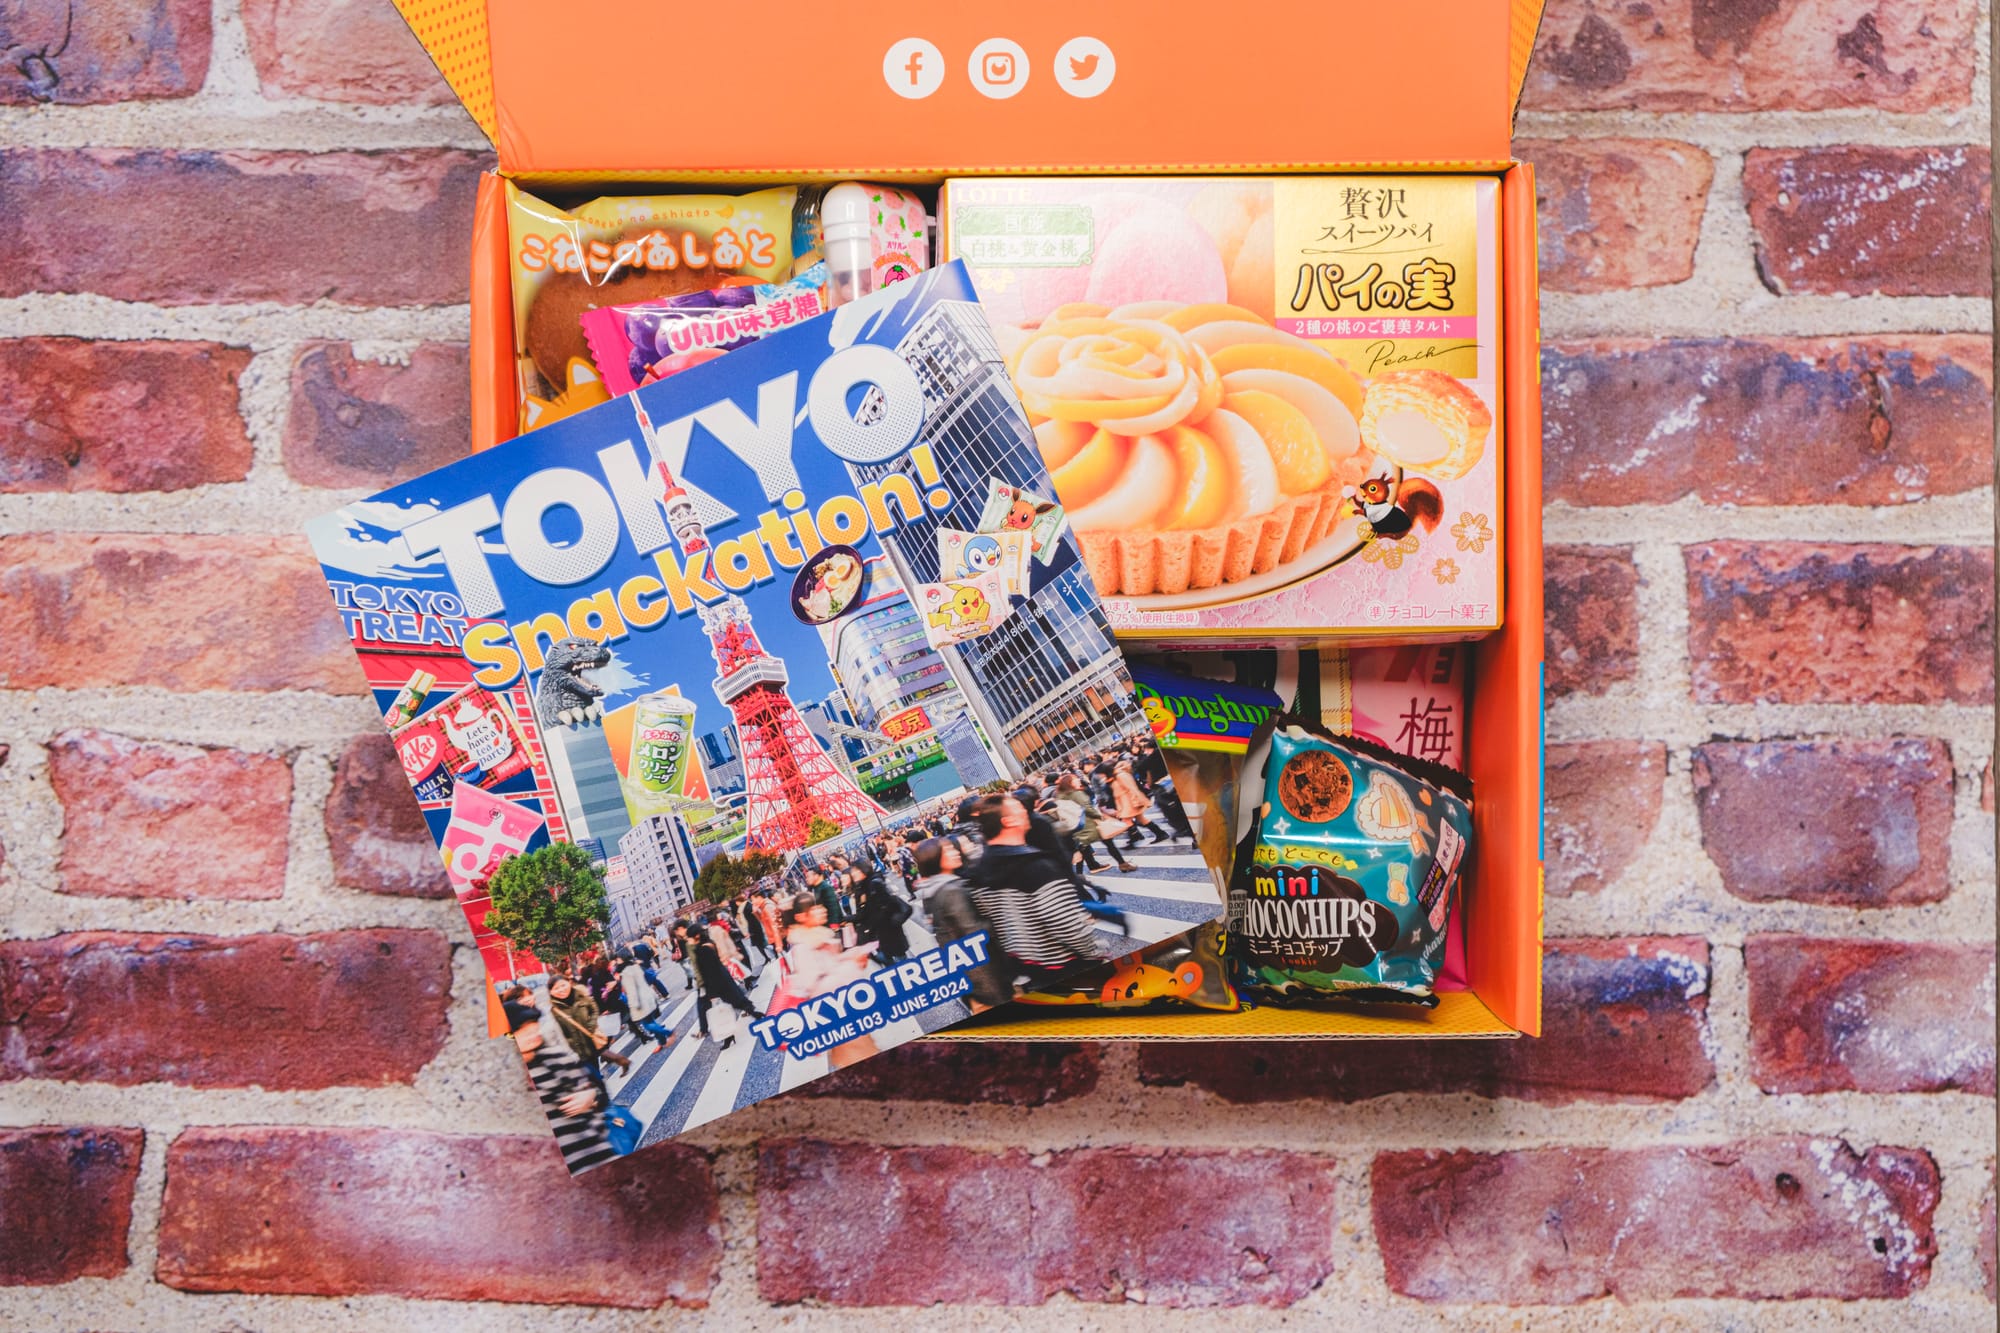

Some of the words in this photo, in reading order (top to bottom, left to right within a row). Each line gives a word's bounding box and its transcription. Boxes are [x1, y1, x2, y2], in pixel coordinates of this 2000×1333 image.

[956, 187, 1032, 201] LOTTE
[1338, 186, 1409, 221] 贅沢
[630, 214, 646, 223] no
[653, 209, 710, 221] ashiato
[1315, 222, 1435, 245] スイーツパイ
[519, 228, 776, 273] こねこのあしあと
[1290, 256, 1456, 312] パイの実
[1295, 318, 1452, 335] 2種の桃のご褒美タルト
[1365, 339, 1472, 374] Peach
[400, 343, 925, 619] TOKYO
[327, 580, 465, 618] TOKYO
[1387, 603, 1491, 620] チョコレート菓子
[336, 607, 469, 647] TREAT
[884, 709, 928, 741] 東京
[1395, 696, 1454, 764] 梅
[638, 743, 685, 761] メロン
[639, 759, 678, 774] クリーム
[416, 772, 449, 796] MILK
[424, 785, 451, 801] TEA
[1255, 868, 1319, 897] mini
[1243, 898, 1377, 939] HOCOCHIPS
[1249, 938, 1345, 957] ミニチョコチップ
[791, 1022, 857, 1058] VOLUME
[856, 1011, 884, 1034] 103
[889, 993, 930, 1019] JUNE
[931, 976, 970, 1003] 2024
